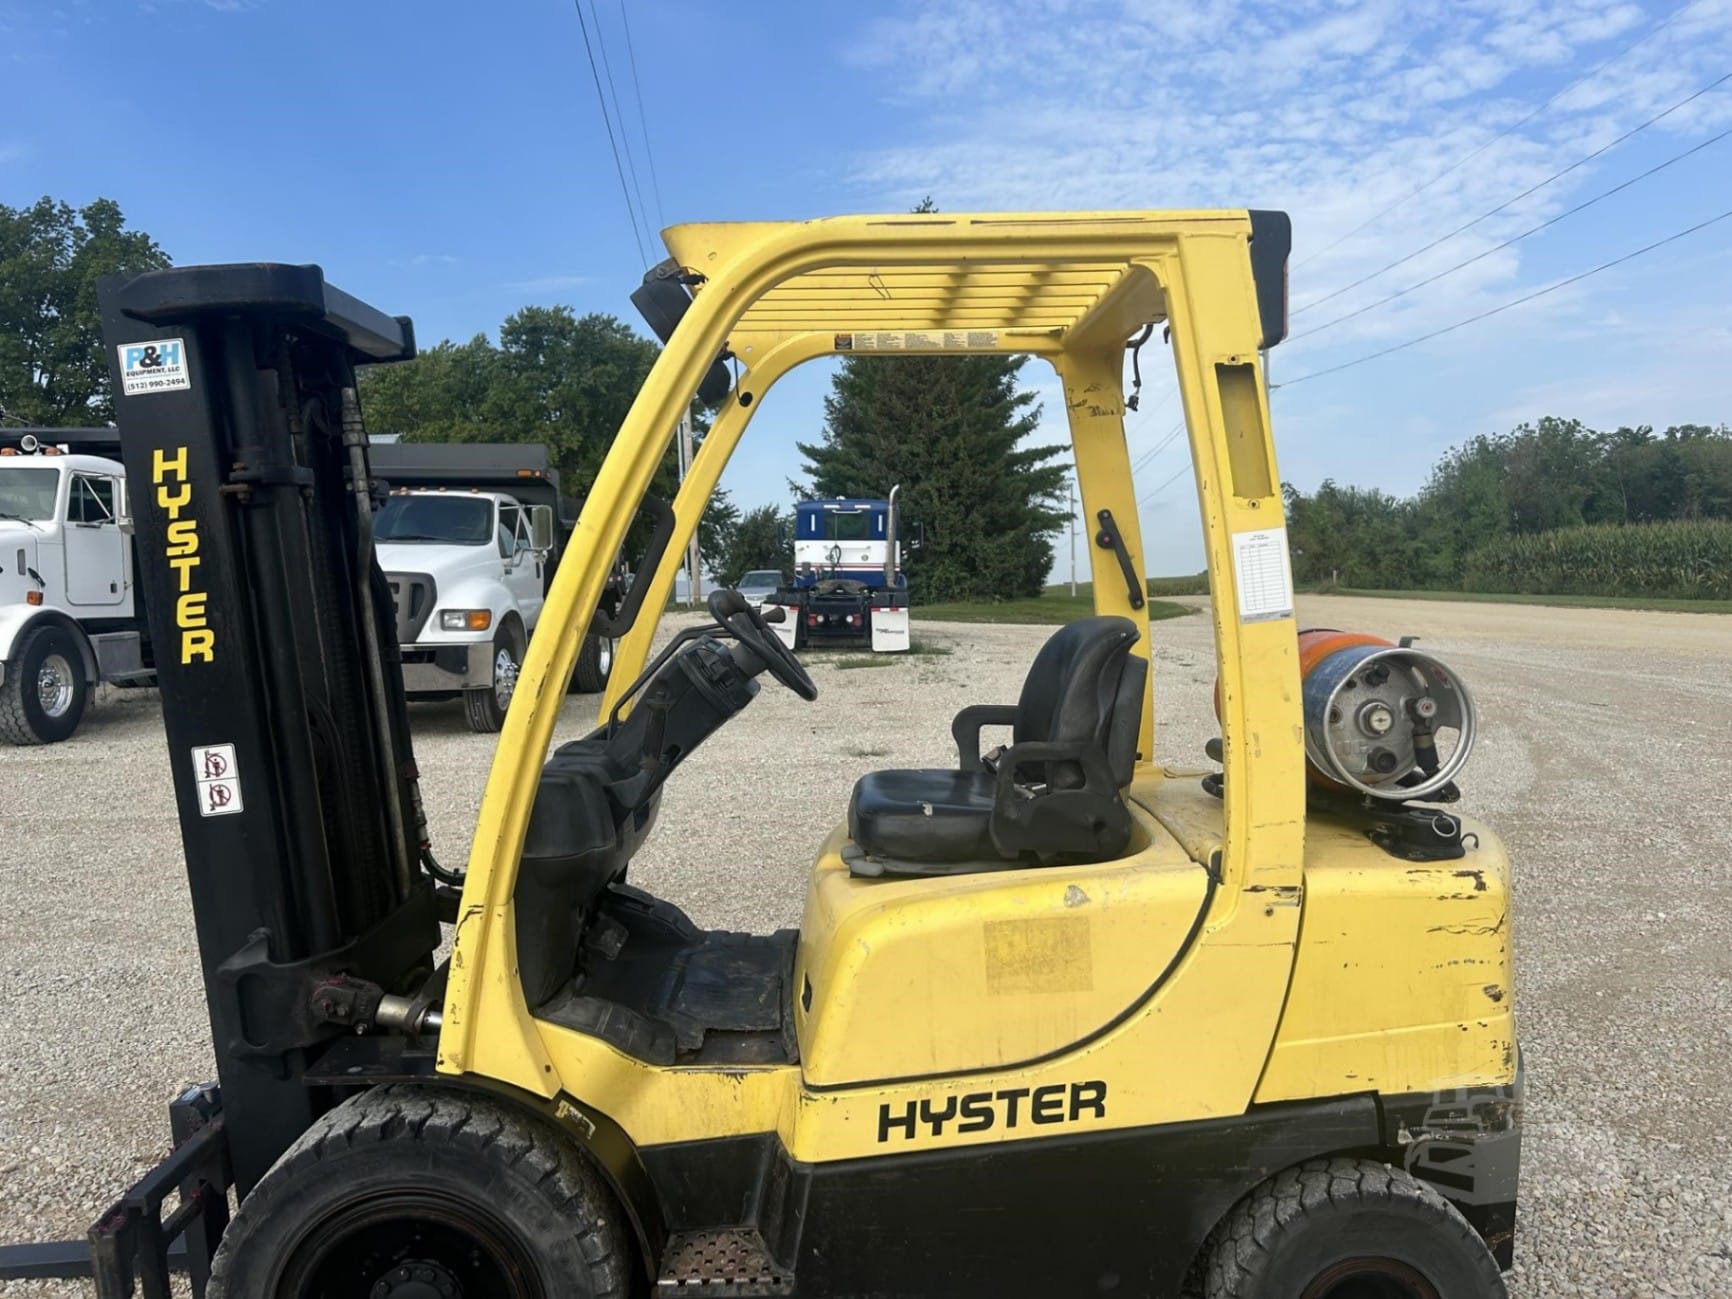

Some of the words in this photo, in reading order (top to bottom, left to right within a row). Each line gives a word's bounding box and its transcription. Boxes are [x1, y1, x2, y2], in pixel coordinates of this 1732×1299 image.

[127, 343, 179, 370] P&H
[153, 447, 215, 664] HYSTER
[878, 1080, 1107, 1142] HYSTER
